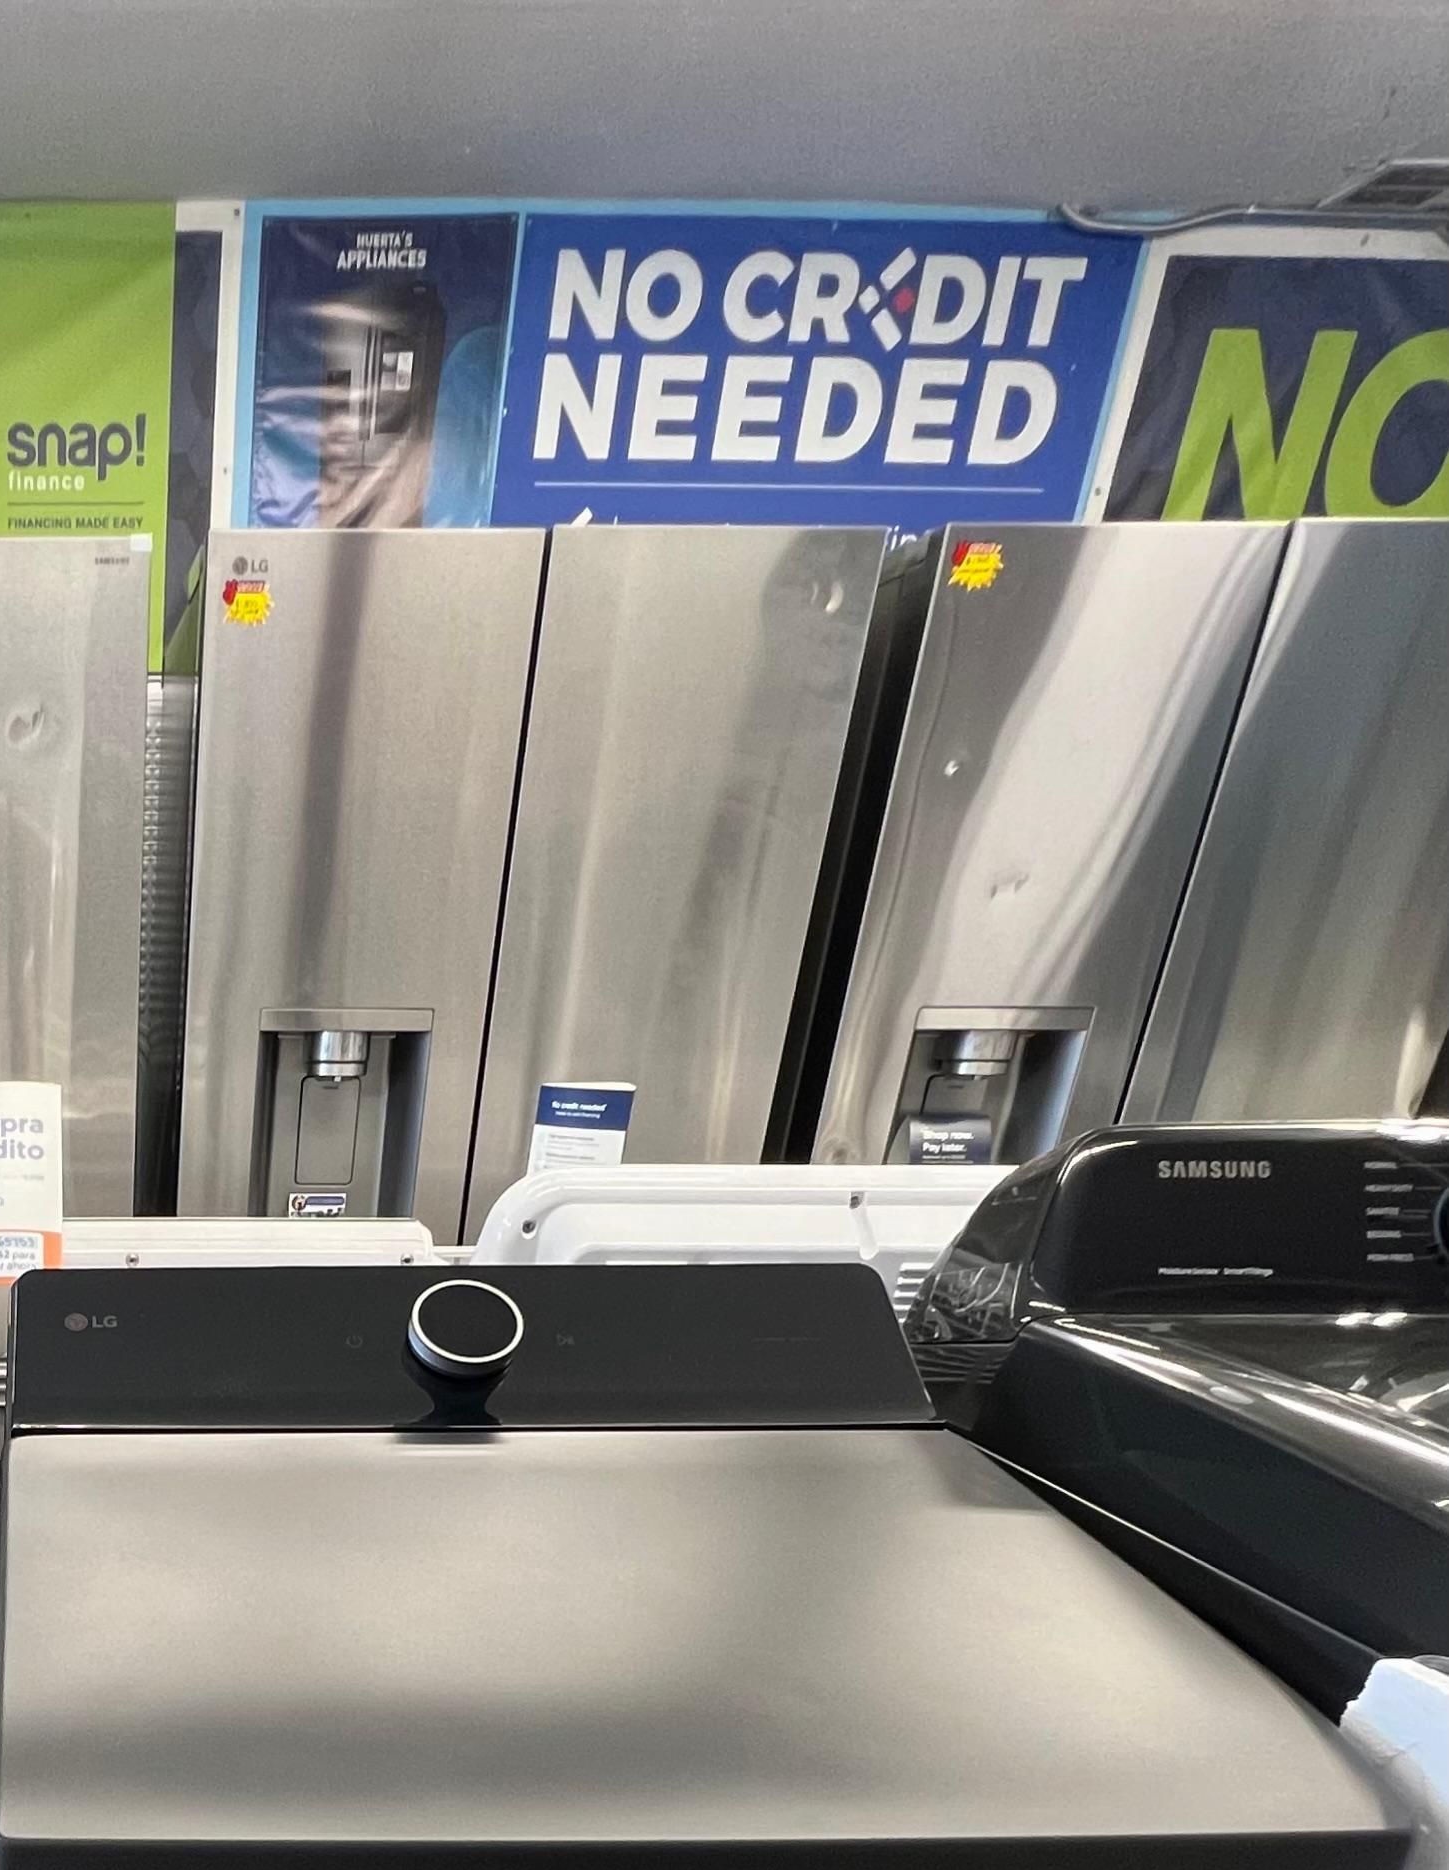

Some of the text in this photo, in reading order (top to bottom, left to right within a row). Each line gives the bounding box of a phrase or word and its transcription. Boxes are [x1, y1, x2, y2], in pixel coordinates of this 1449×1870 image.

[336, 249, 428, 271] APPLIANCES
[548, 248, 704, 343] NO
[532, 352, 1058, 466] NEEDED
[7, 412, 147, 482] snap!
[8, 470, 86, 492] finance
[7, 516, 144, 530] FINANCING MADE EASY
[251, 558, 269, 574] LG
[1157, 1160, 1272, 1179] SAMSUNG
[92, 1315, 118, 1328] LG
